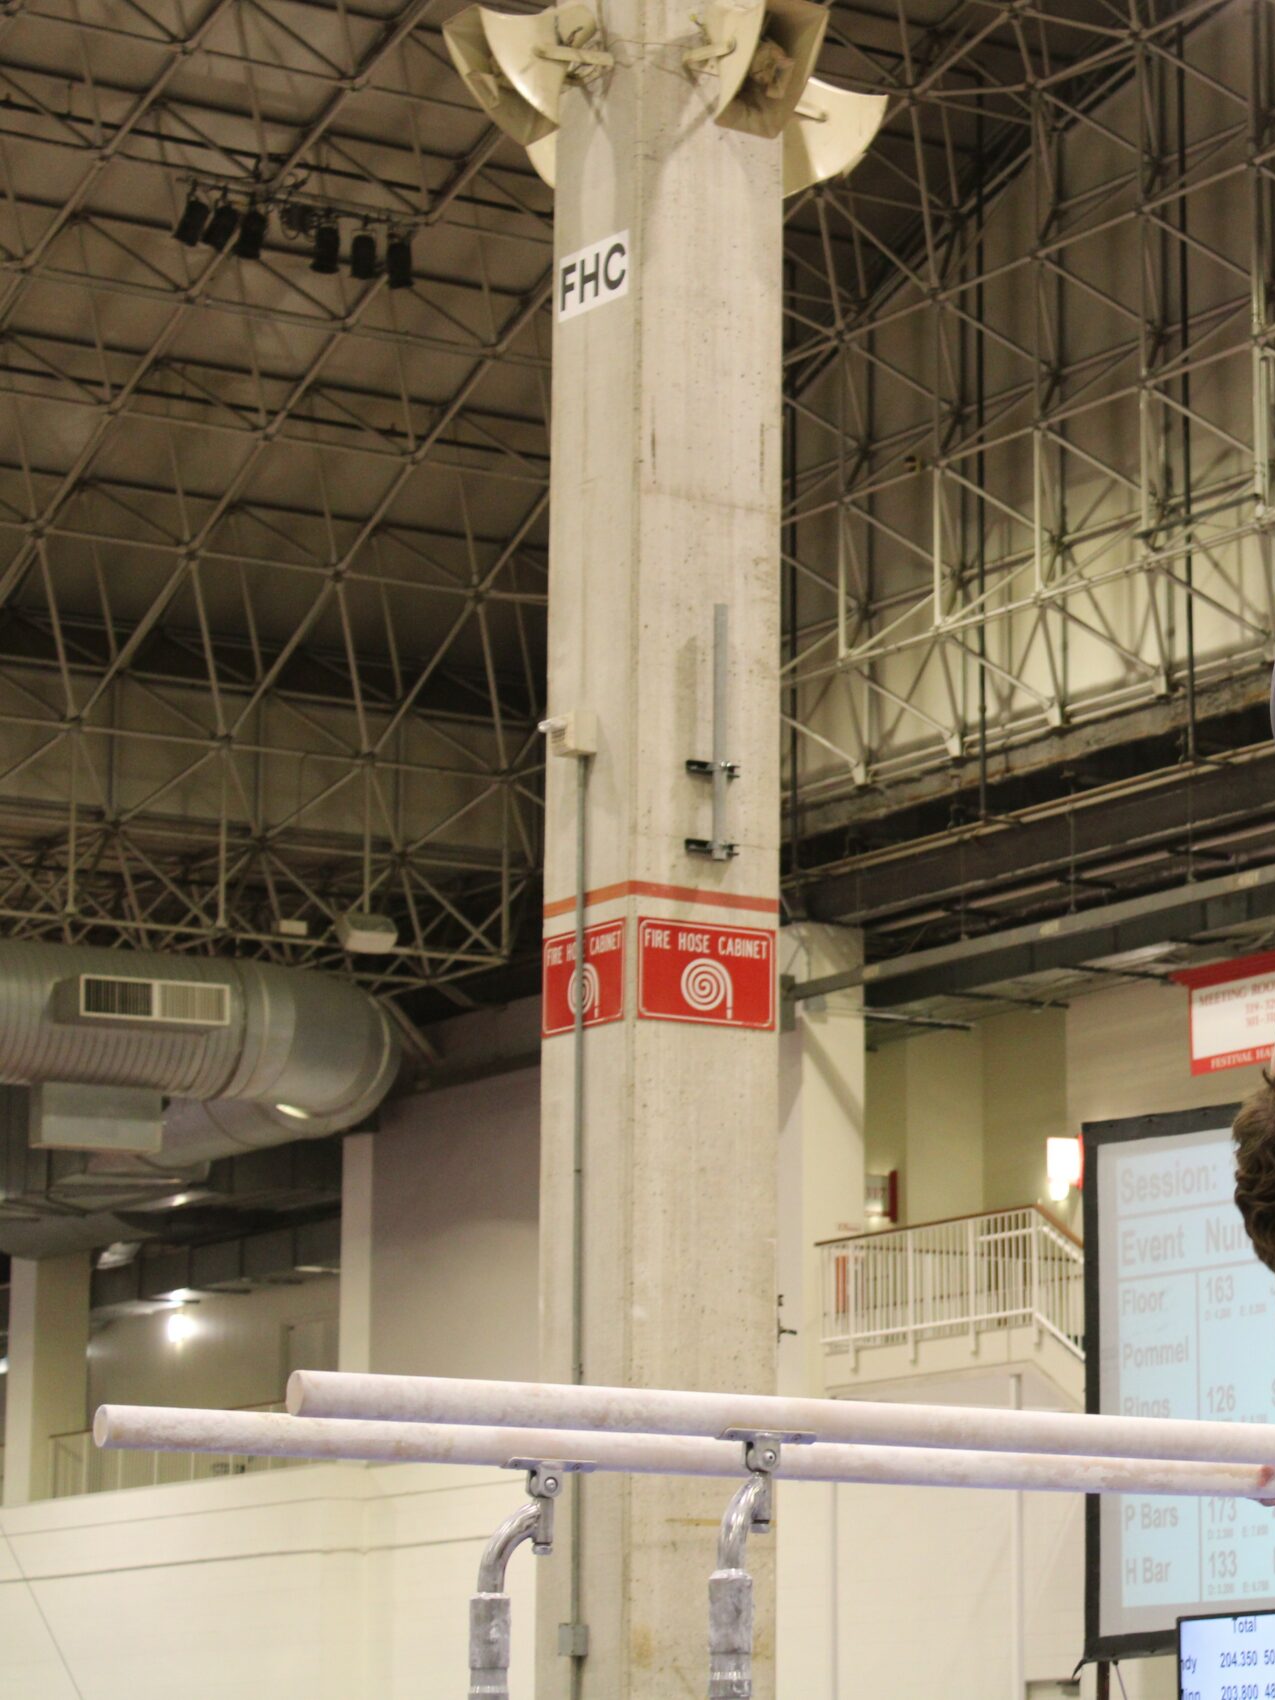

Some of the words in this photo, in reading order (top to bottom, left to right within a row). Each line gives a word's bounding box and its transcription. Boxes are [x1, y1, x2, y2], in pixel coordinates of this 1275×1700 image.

[560, 243, 626, 312] FHC
[547, 945, 563, 967] FIRE
[590, 930, 622, 956] CABINET
[644, 928, 671, 950] FIRE
[678, 932, 711, 953] HOSE
[718, 936, 768, 960] CABINET
[1210, 1051, 1254, 1070] FESTIVAL
[1255, 1045, 1275, 1060] HA
[1121, 1160, 1217, 1204] Session:
[1121, 1225, 1185, 1267] Event
[1122, 1288, 1165, 1316] Floor
[1206, 1275, 1234, 1304] 163
[1123, 1335, 1189, 1369] Pommel
[1207, 1385, 1236, 1414] 126
[1124, 1504, 1135, 1532] P
[1141, 1503, 1179, 1530] Bars
[1208, 1497, 1237, 1523] 173
[1126, 1557, 1137, 1585] H
[1142, 1556, 1171, 1584] Bar
[1209, 1550, 1238, 1578] 133
[1232, 1616, 1257, 1634] Total
[1220, 1650, 1258, 1668] 204.350
[1221, 1683, 1258, 1700] 203.800
